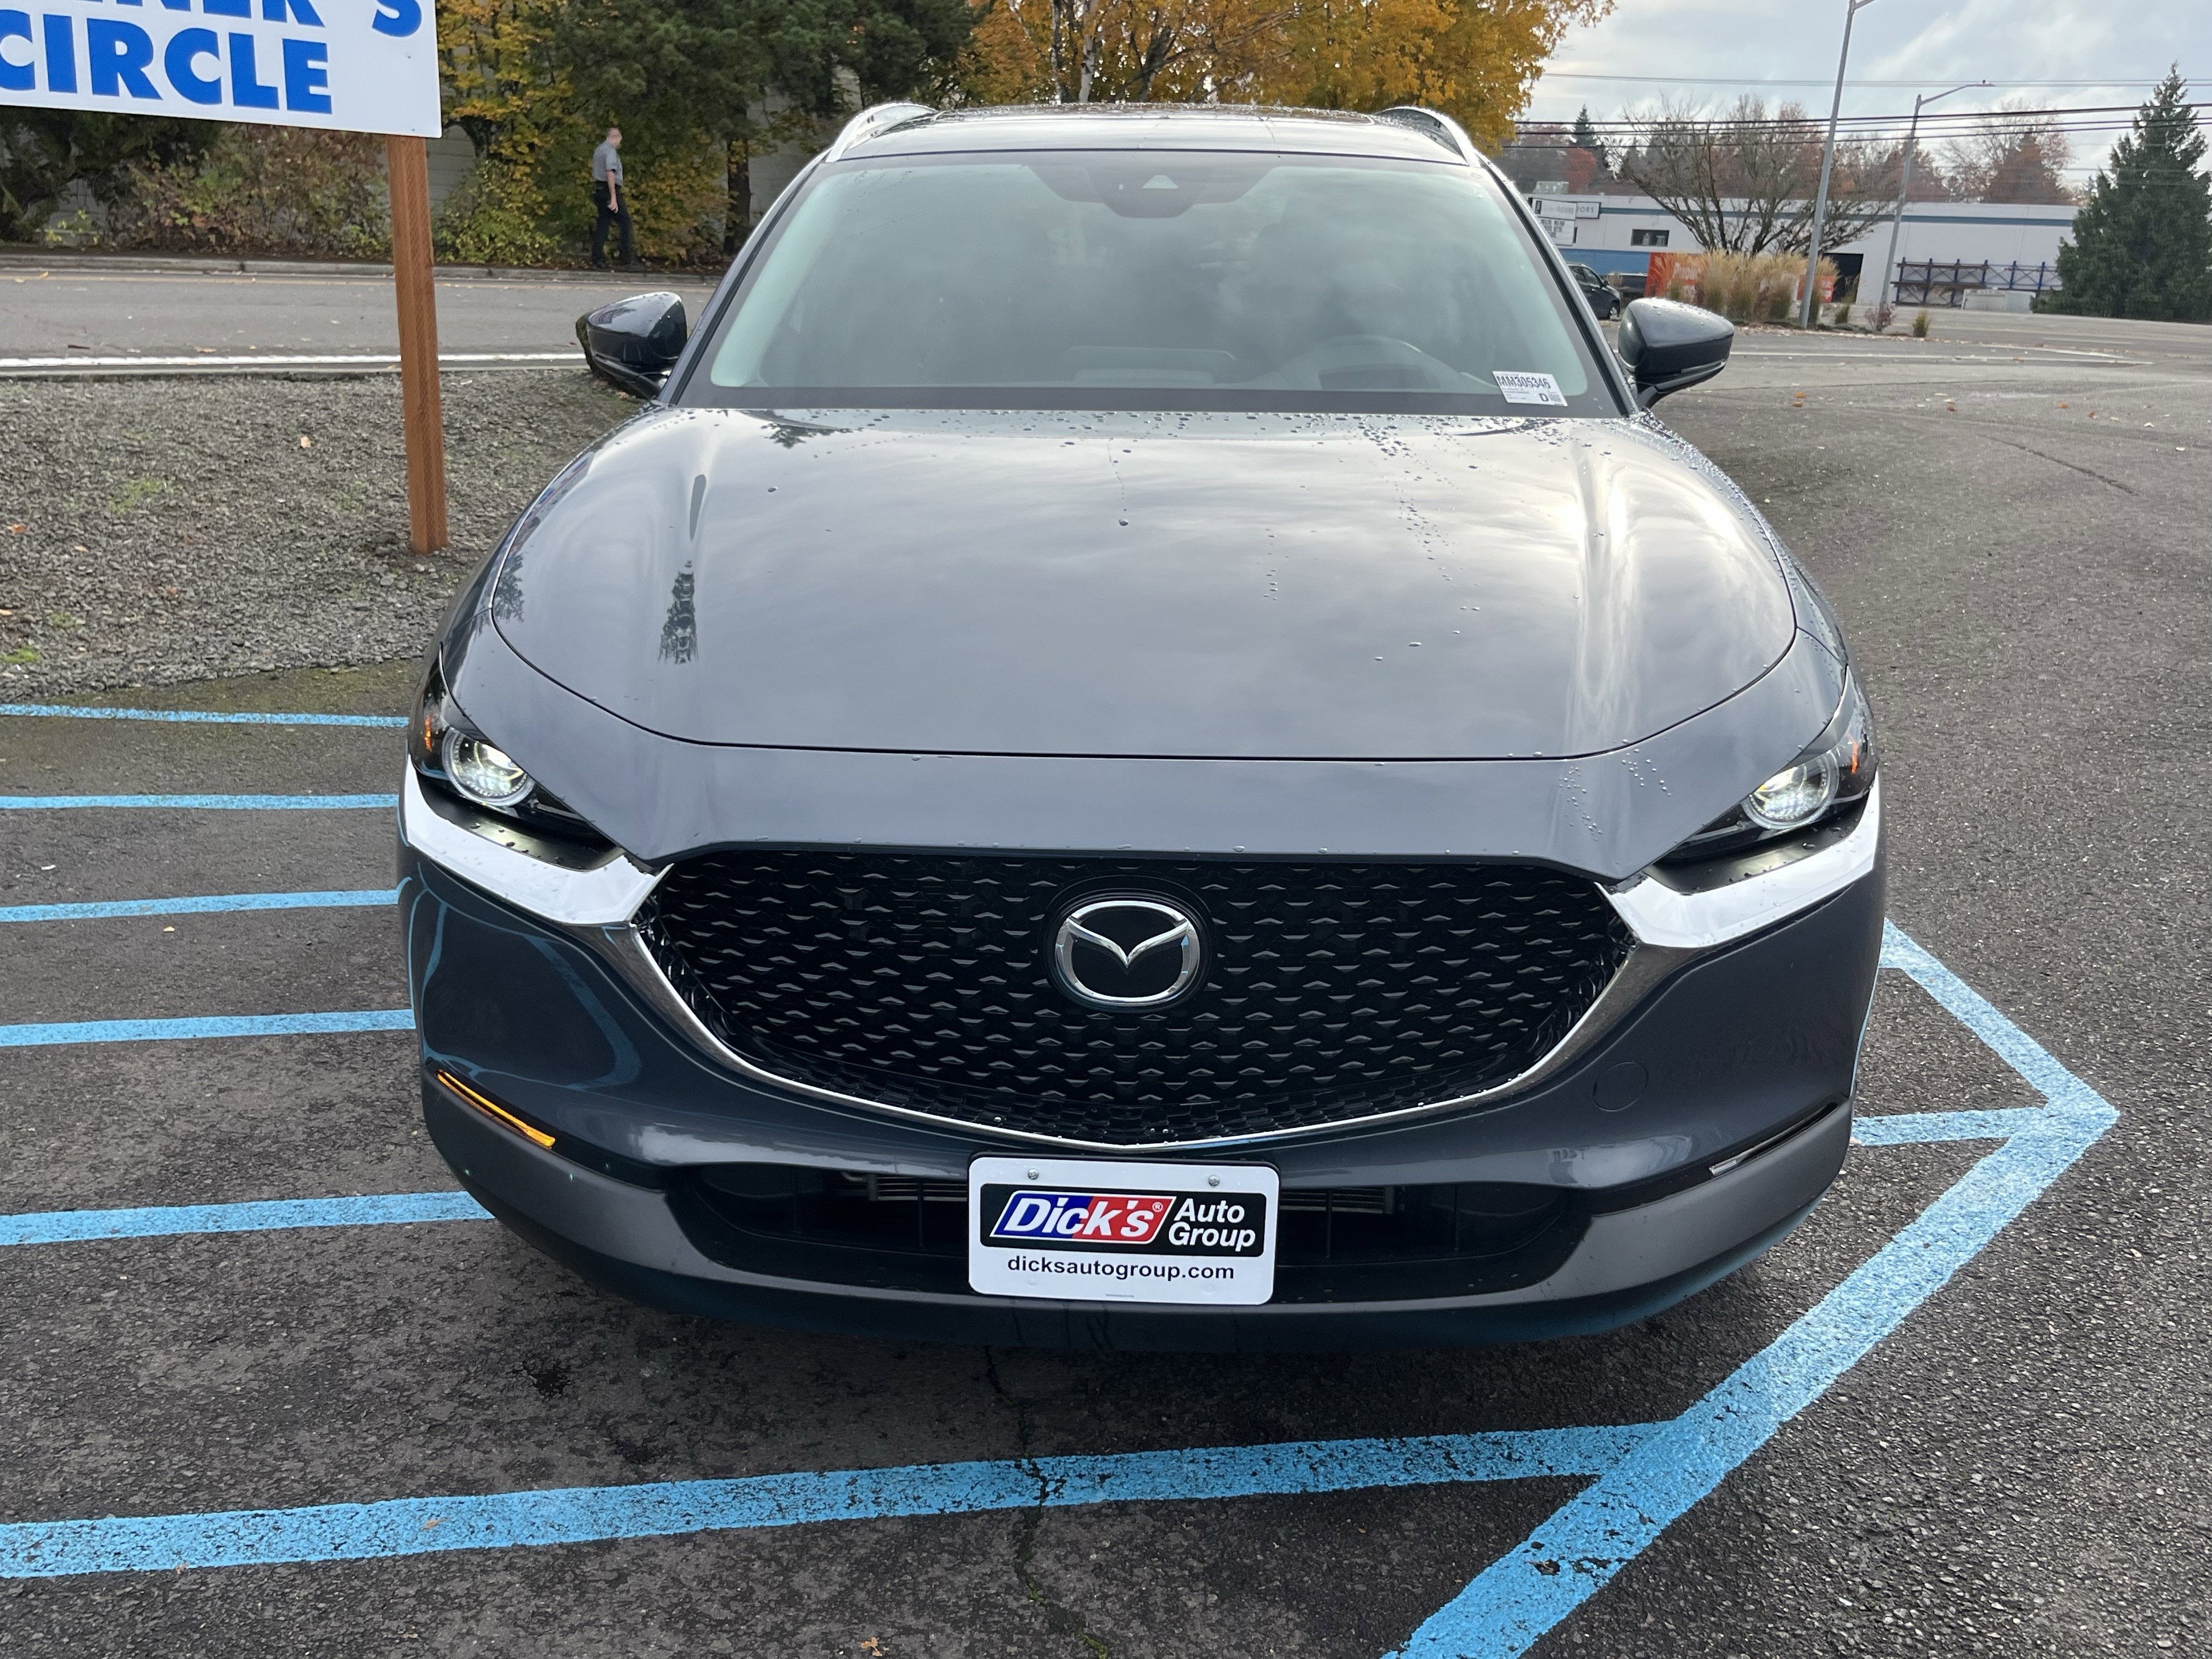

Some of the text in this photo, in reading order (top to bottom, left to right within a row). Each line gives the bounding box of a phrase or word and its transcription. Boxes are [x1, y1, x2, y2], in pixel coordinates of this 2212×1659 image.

[0, 9, 332, 114] CIRCLE
[1496, 376, 1551, 388] MM305346
[1003, 1197, 1151, 1237] Dick's
[1174, 1198, 1245, 1223] Auto
[1169, 1221, 1256, 1252] Group
[1008, 1255, 1234, 1282] dicksautogroup.com
